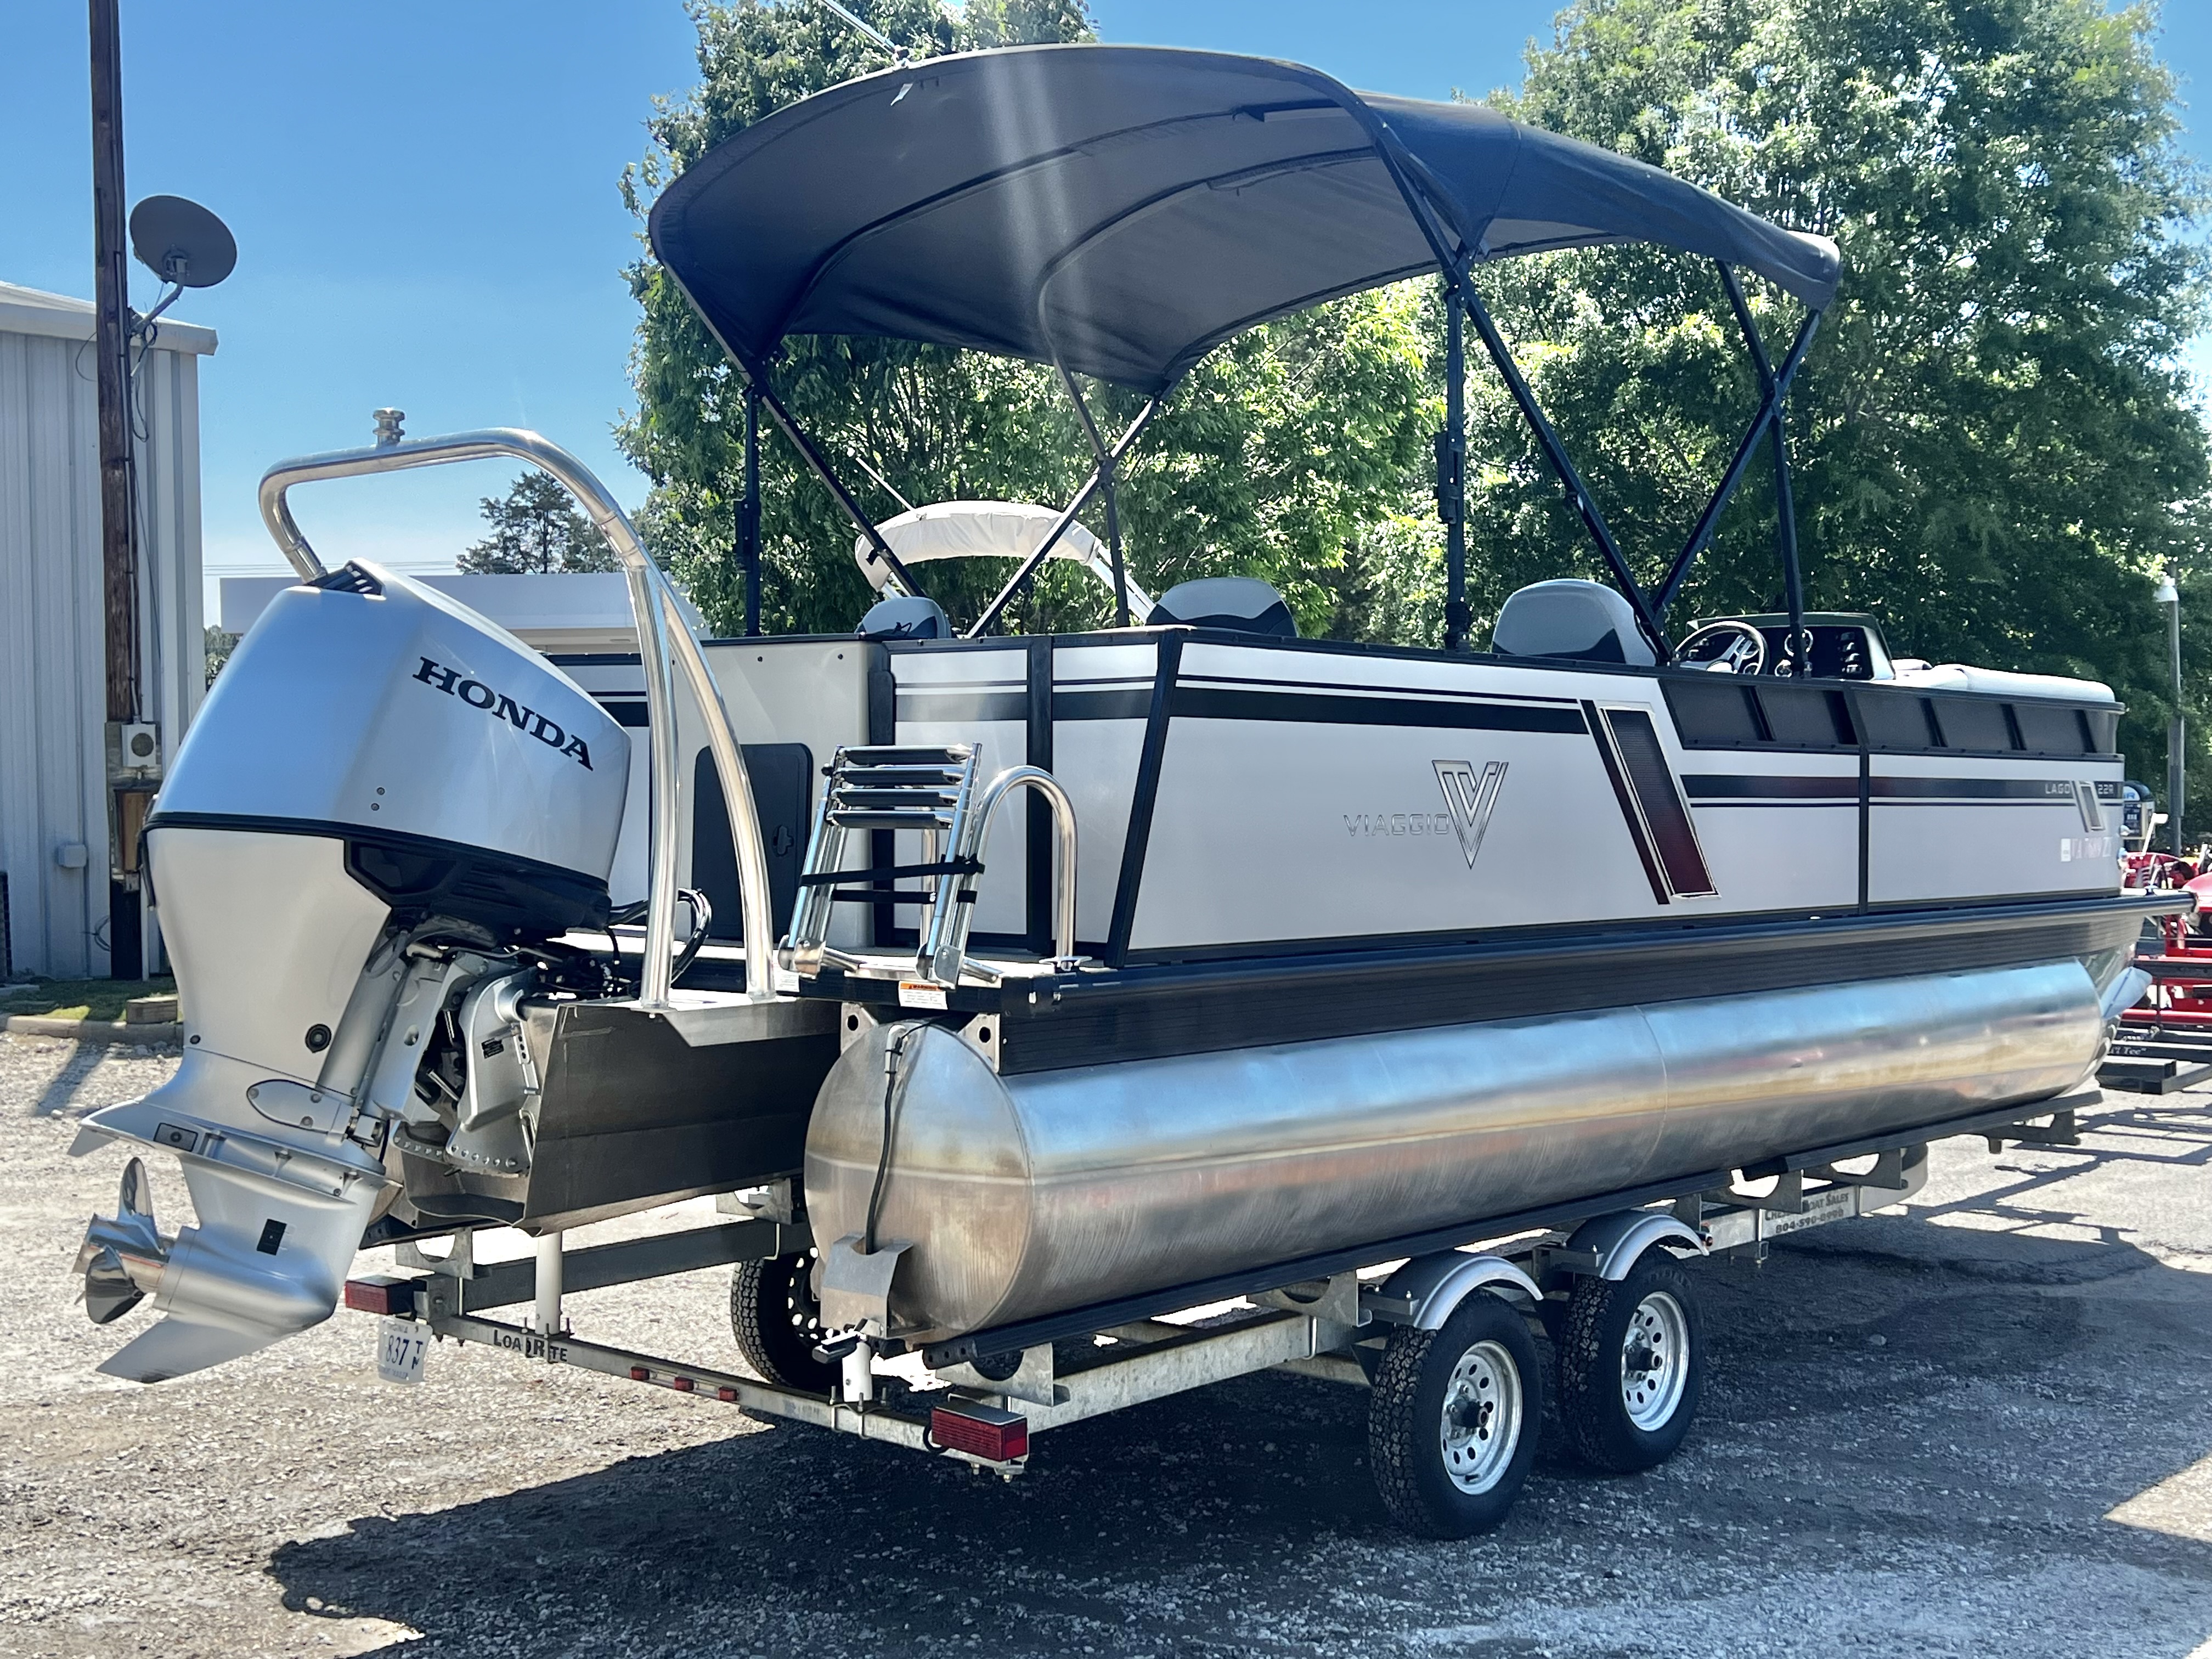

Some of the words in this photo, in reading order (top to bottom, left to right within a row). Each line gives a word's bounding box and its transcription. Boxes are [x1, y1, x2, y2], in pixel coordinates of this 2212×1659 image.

[413, 656, 594, 771] HONDA
[2045, 783, 2070, 794] LAGO
[1343, 814, 1450, 837] VIAGGIO
[1803, 1198, 1824, 1212] OAT
[386, 1335, 410, 1365] 837
[493, 1329, 568, 1362] LOADRTE
